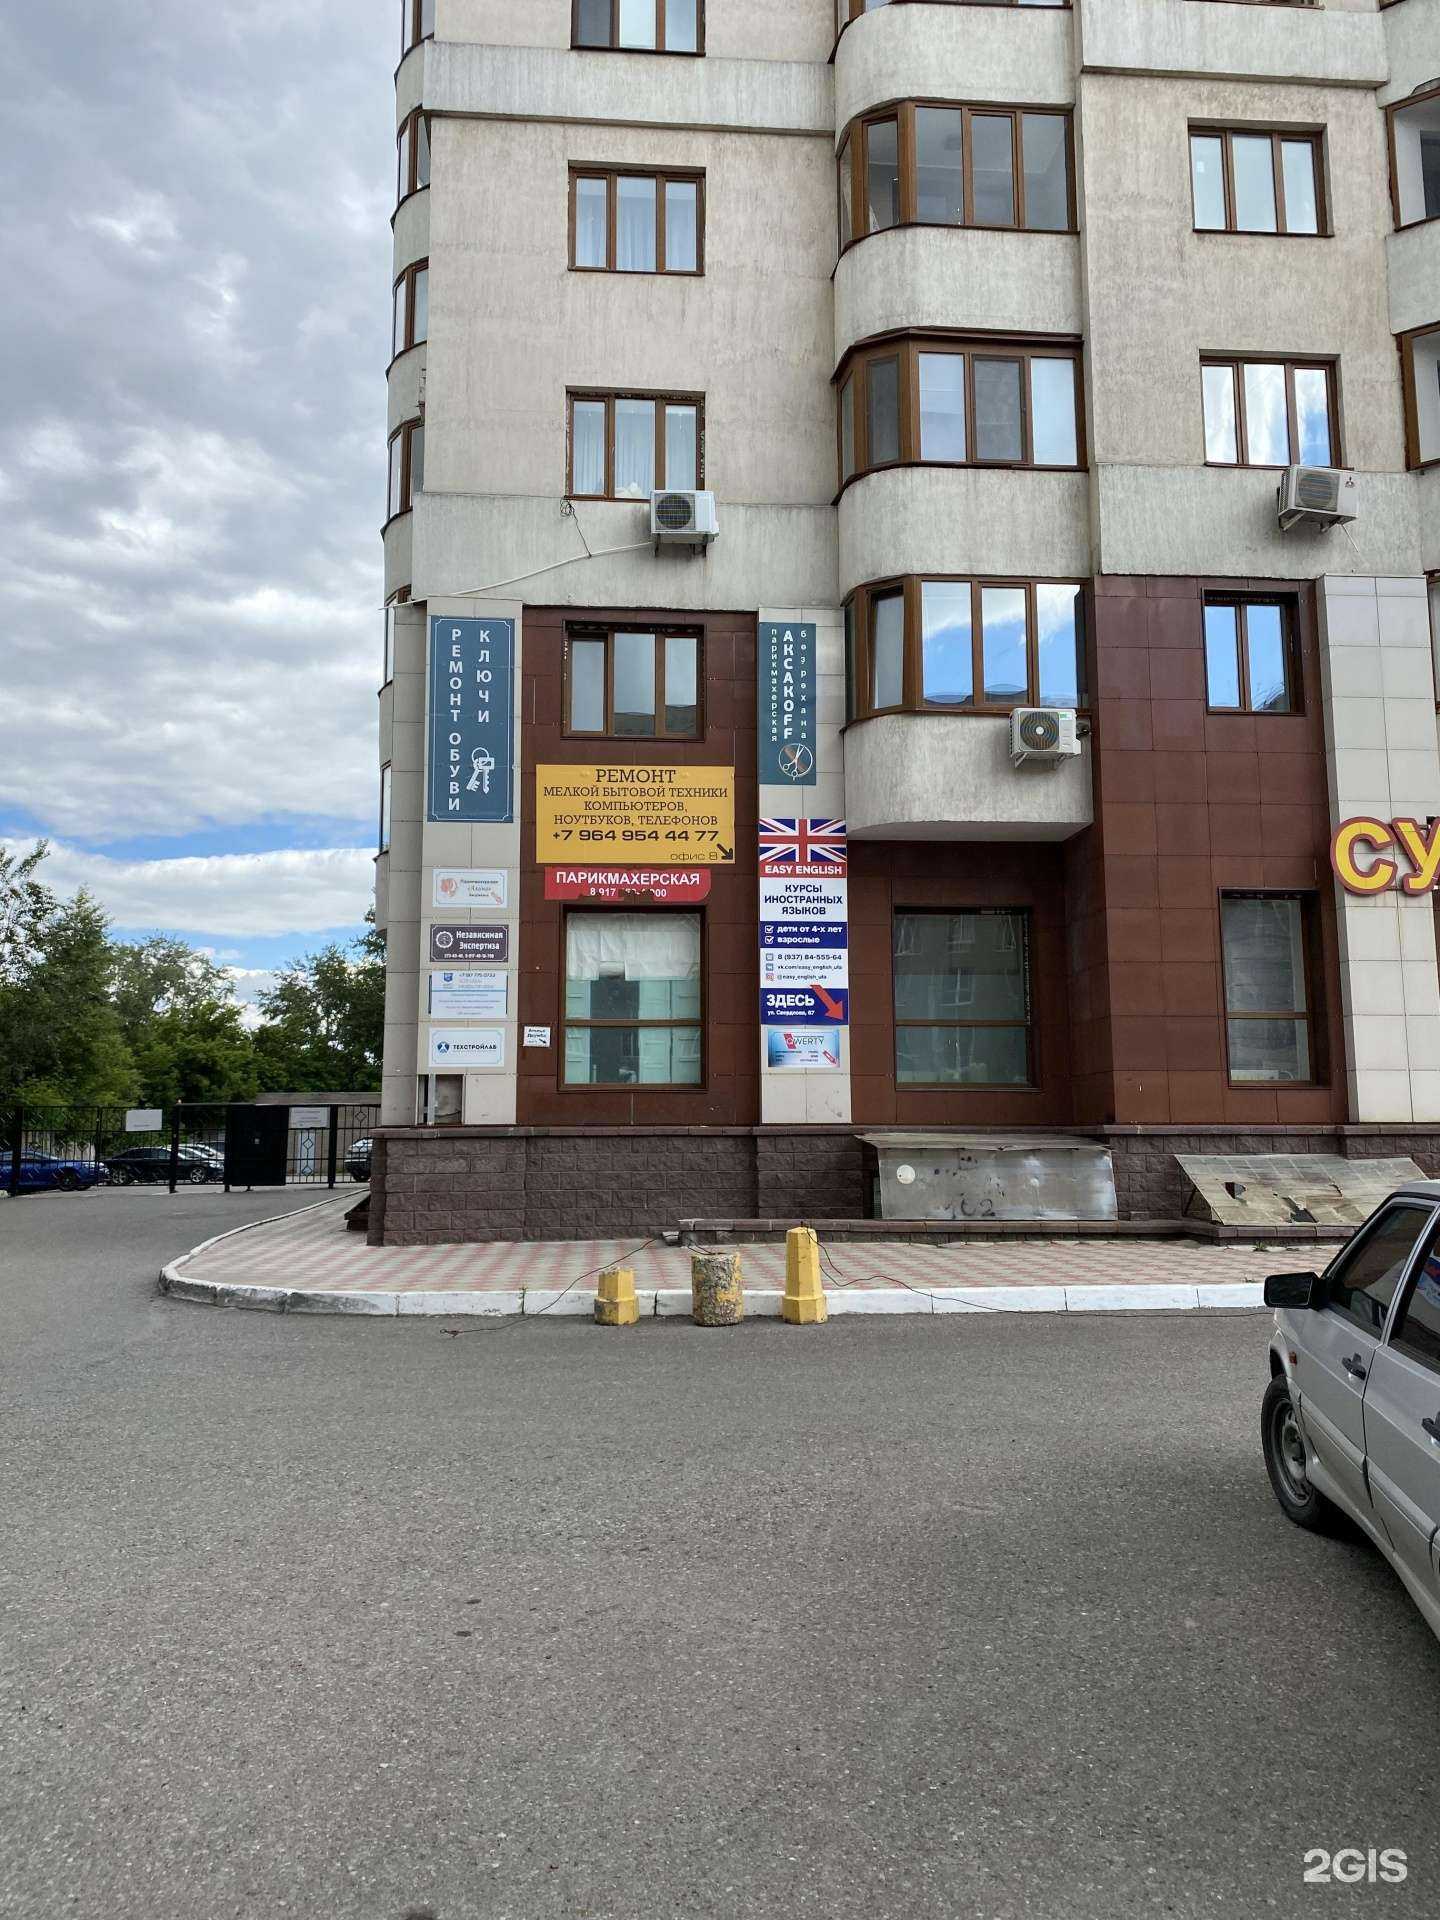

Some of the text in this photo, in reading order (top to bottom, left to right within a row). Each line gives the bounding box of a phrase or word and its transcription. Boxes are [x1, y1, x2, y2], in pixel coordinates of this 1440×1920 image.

[476, 629, 492, 723] КЛЮЧИ
[770, 628, 778, 742] парикмахерская
[448, 628, 463, 811] РЕМОНТ ОБУВИ
[595, 768, 676, 783] РЕМОНТ
[544, 786, 727, 798] МЕЛКОЙ БЫТОВОЙ ТЕХНИКИ
[584, 801, 688, 812] КОМПЬЮТЕРОВ,
[554, 814, 718, 826] НОУТБУКОВ, ТЕЛЕФОНОВ
[552, 829, 719, 842] +7 964 954 44 77
[670, 851, 718, 861] офис 8
[765, 865, 842, 874] EASY ENGLISH
[556, 871, 700, 886] ПАРИКМАХЕРСКАЯ
[590, 887, 596, 896] 8
[599, 887, 616, 896] 917
[785, 885, 822, 893] КУРСЫ
[764, 895, 843, 904] ИНОСТРАННЫХ
[782, 906, 826, 915] ЯЗЫКОВ
[456, 931, 503, 939] Независимая
[459, 941, 499, 951] Экспертиза
[766, 994, 815, 1008] ЗДЕСЬ
[453, 1043, 497, 1051] ТЕХСТРОЙЛАБ
